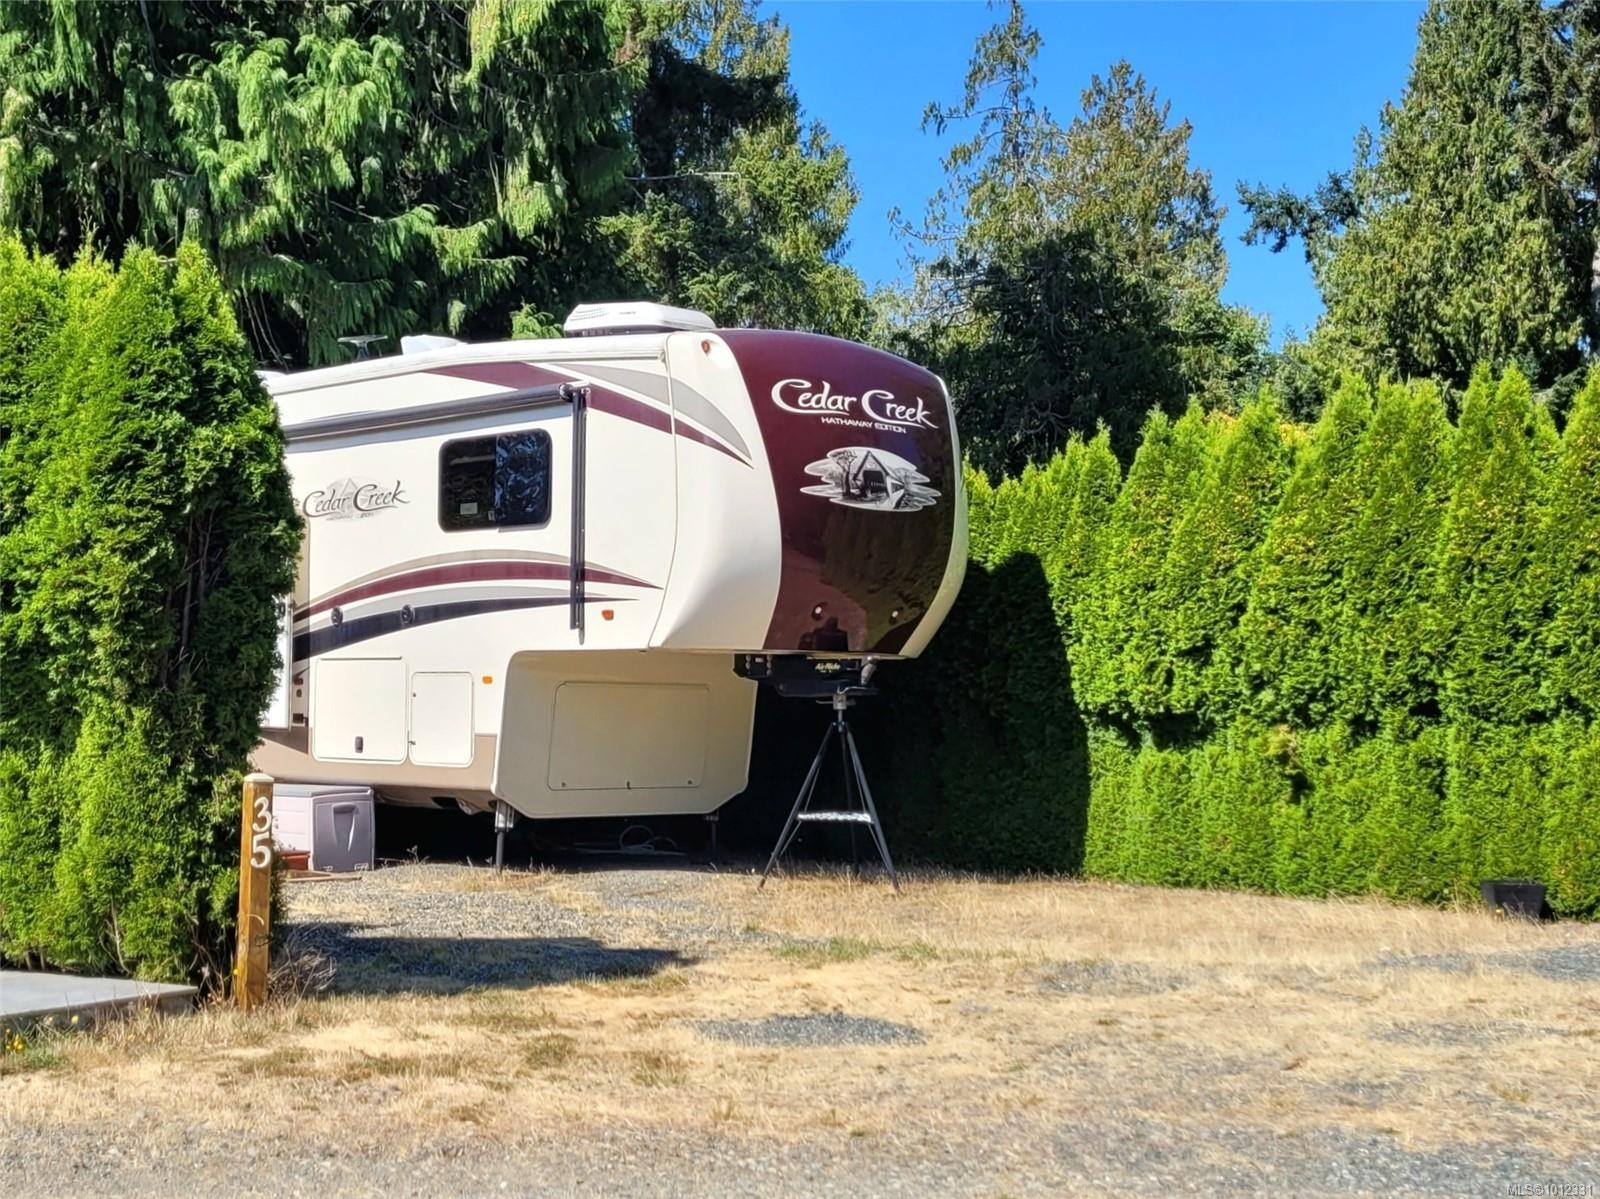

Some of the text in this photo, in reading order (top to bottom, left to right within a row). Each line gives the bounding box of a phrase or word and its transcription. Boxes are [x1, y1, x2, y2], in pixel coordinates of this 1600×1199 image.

[771, 378, 939, 429] Cedar Creek
[821, 416, 907, 434] HATHAWAY EDITION
[303, 480, 411, 518] Cedar Creek
